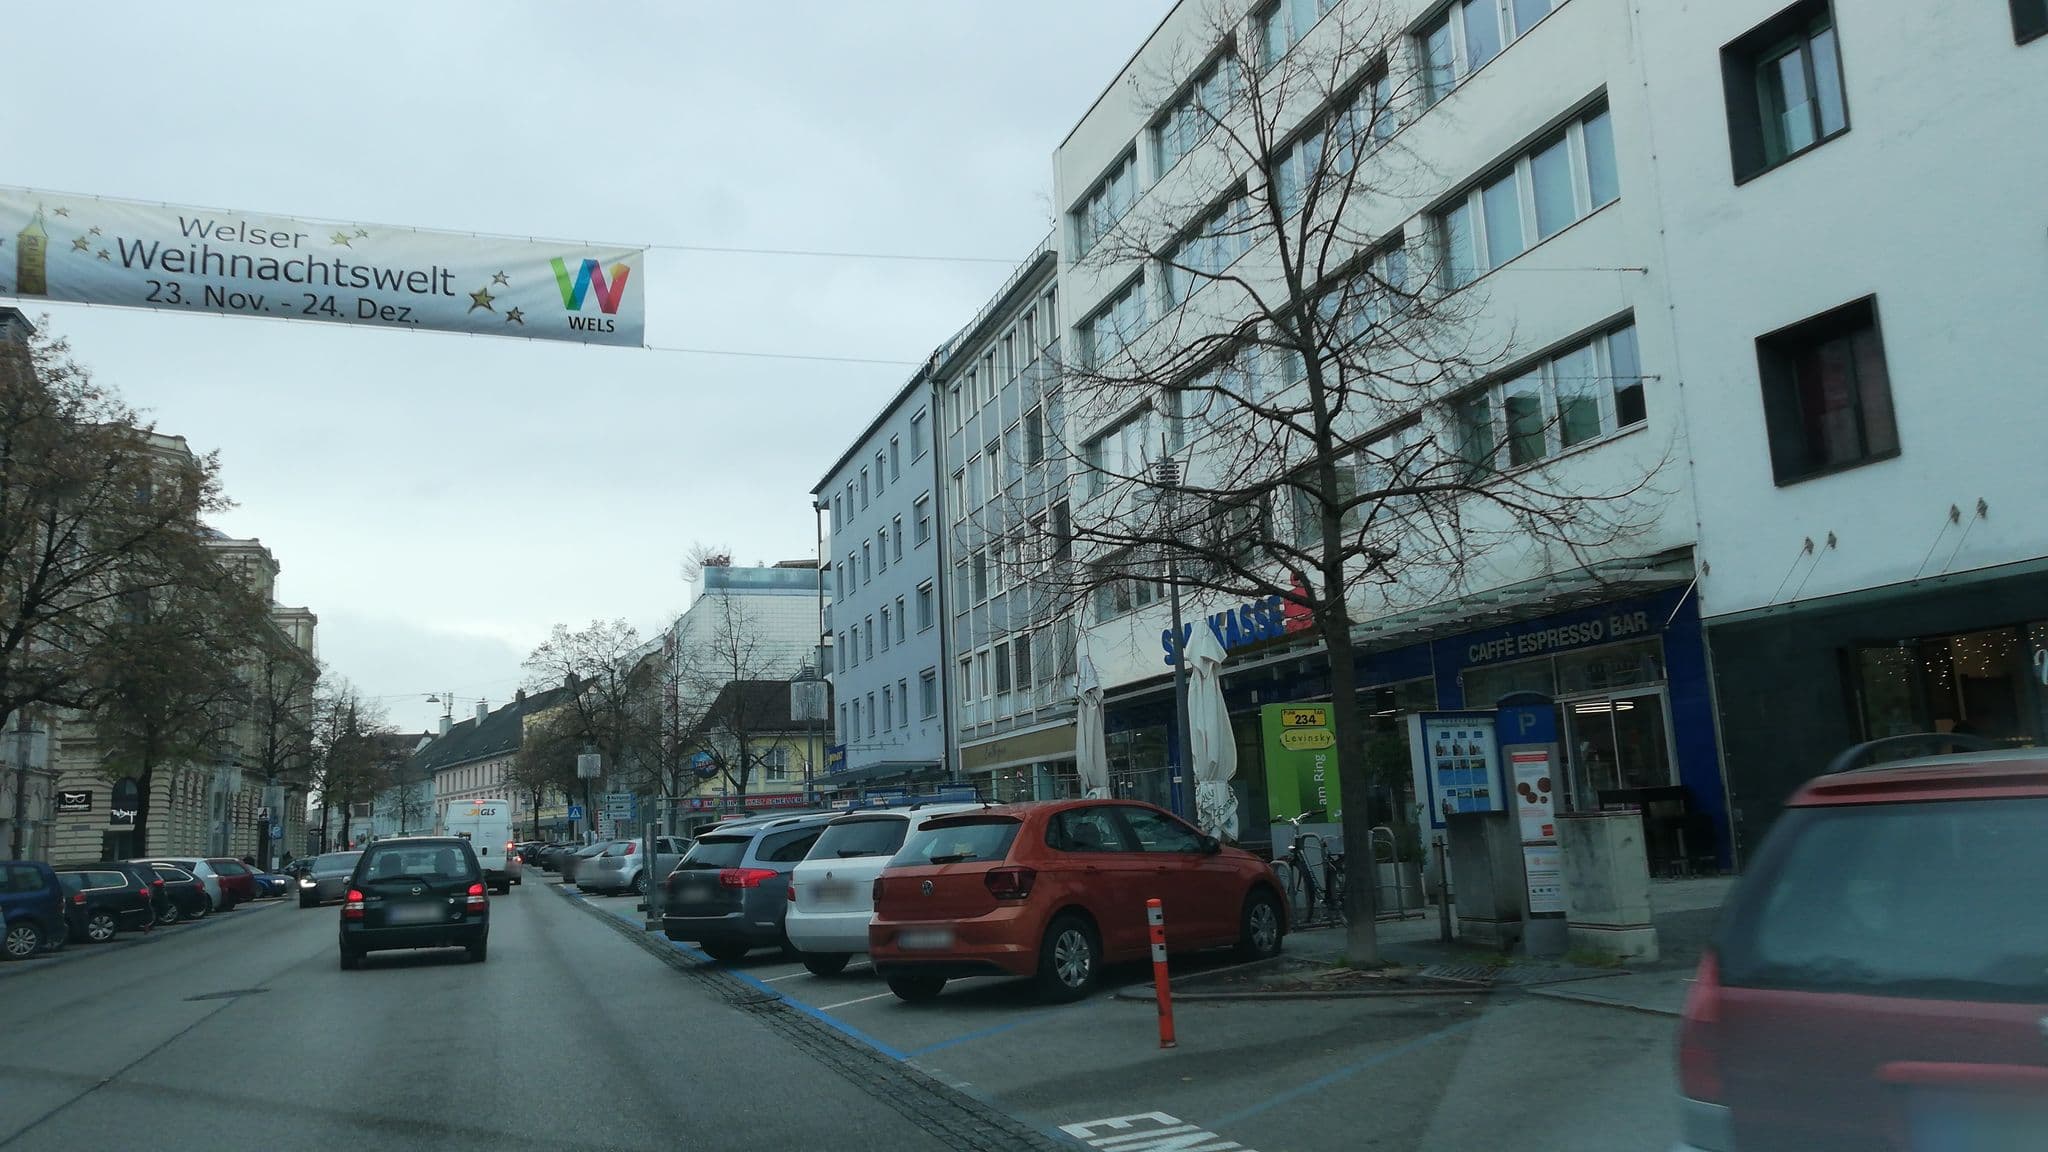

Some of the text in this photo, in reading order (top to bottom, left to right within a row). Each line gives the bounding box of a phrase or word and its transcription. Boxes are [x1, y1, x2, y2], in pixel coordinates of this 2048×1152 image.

[178, 216, 309, 249] Welser
[117, 236, 456, 297] Weihnachtswelt
[145, 279, 191, 306] 23.
[204, 284, 270, 311] Nov.
[302, 292, 345, 318] 24.
[357, 296, 420, 324] Dez.
[567, 315, 615, 333] WELS
[1469, 611, 1649, 662] CAFFÈ ESPRESSO BAR
[1295, 714, 1317, 725] 234
[1519, 713, 1536, 735] P
[1313, 754, 1328, 806] am Ring
[480, 808, 497, 816] GLS
